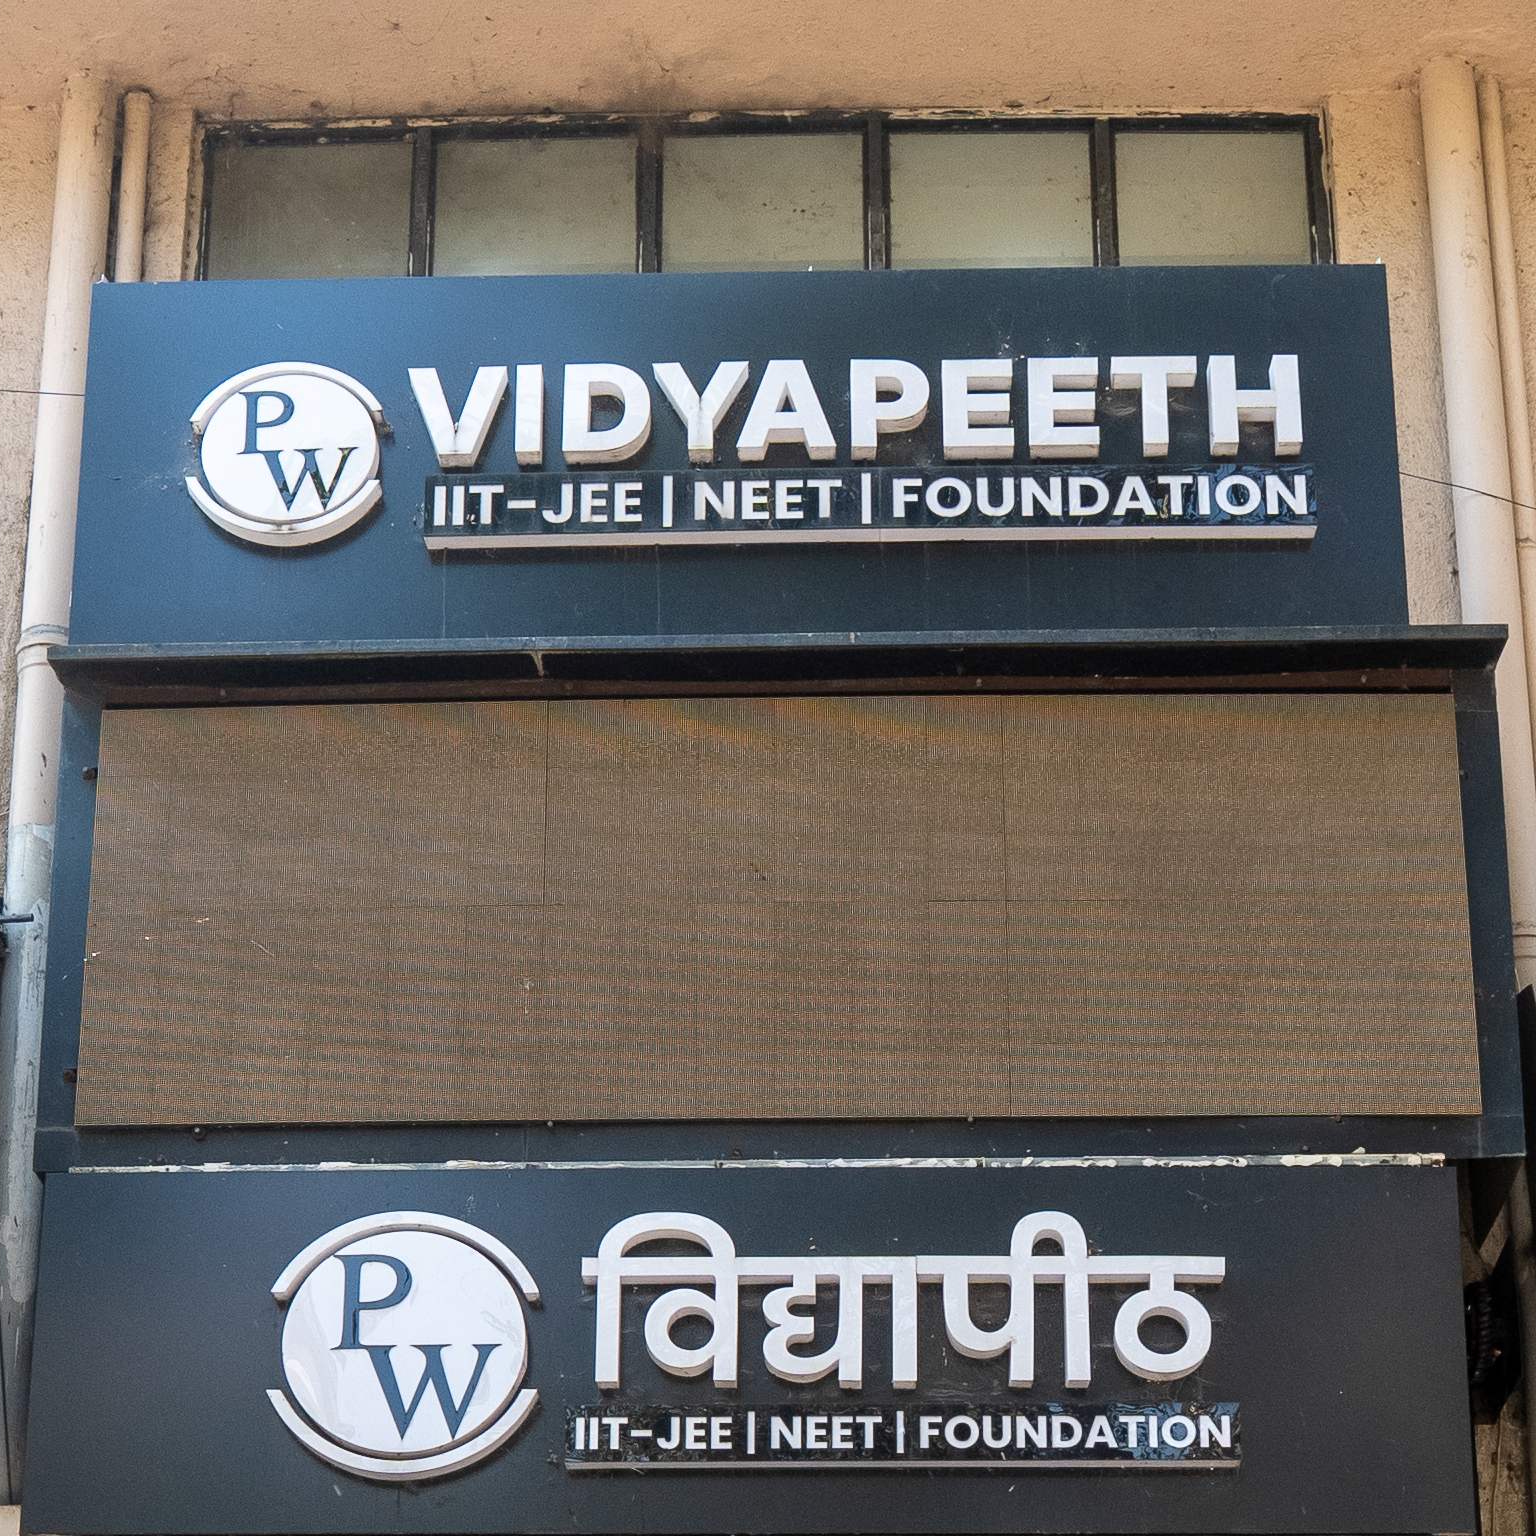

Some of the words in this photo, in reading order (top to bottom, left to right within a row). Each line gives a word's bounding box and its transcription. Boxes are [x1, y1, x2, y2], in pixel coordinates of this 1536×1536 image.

[407, 352, 1303, 469] VIDYAPEETH
[432, 476, 644, 528] IIT-JEE
[694, 476, 843, 522] NEET
[891, 471, 1309, 521] FOUNDATION
[581, 1211, 1225, 1390] विद्यापीठ
[575, 1414, 733, 1450] IIT-JEE
[769, 1414, 882, 1450] NEET
[917, 1412, 1232, 1450] FOUNDATION
